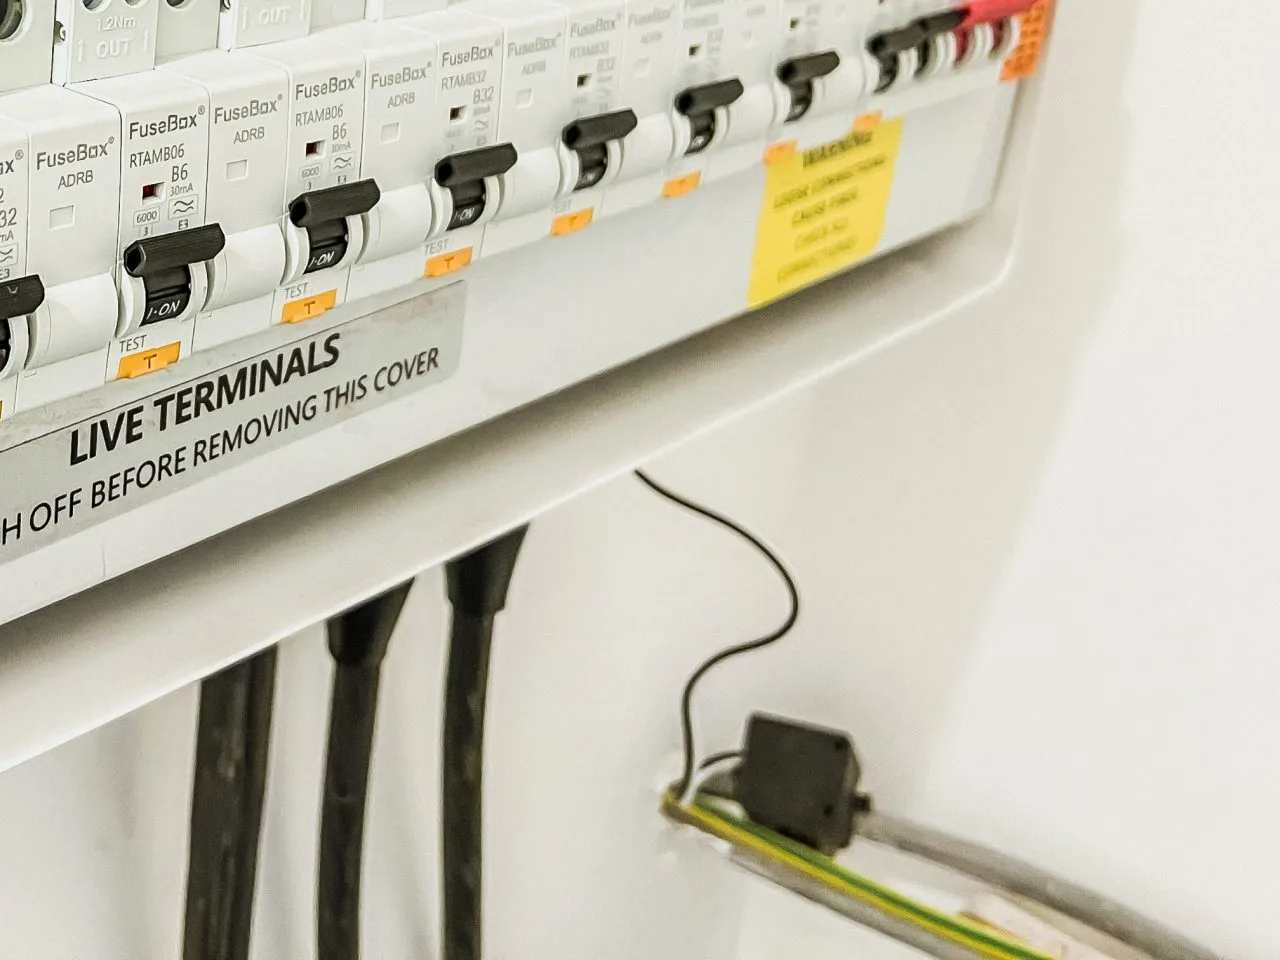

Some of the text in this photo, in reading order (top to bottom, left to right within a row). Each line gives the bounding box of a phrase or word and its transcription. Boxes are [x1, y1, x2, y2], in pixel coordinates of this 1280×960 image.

[96, 38, 133, 59] OUT
[387, 92, 415, 109] ADRB
[472, 86, 494, 104] B32
[295, 103, 344, 127] RTAMB06
[233, 127, 265, 144] ADRB
[332, 123, 347, 140] B6
[129, 143, 185, 168] RTAMB06
[58, 170, 94, 189] ADRB
[171, 163, 188, 183] B6
[170, 182, 193, 196] 30mA
[136, 210, 157, 223] 6000
[424, 239, 449, 256] TEST
[444, 256, 455, 268] T
[284, 282, 308, 300] TEST
[304, 301, 315, 315] T
[120, 335, 147, 354] TEST
[143, 354, 157, 369] T
[70, 333, 340, 466] LIVE TERMINALS
[30, 488, 82, 531] OFF
[91, 446, 187, 509] BEFORE
[193, 395, 317, 467] REMOVING
[323, 374, 368, 412] THIS
[373, 347, 439, 391] COVER
